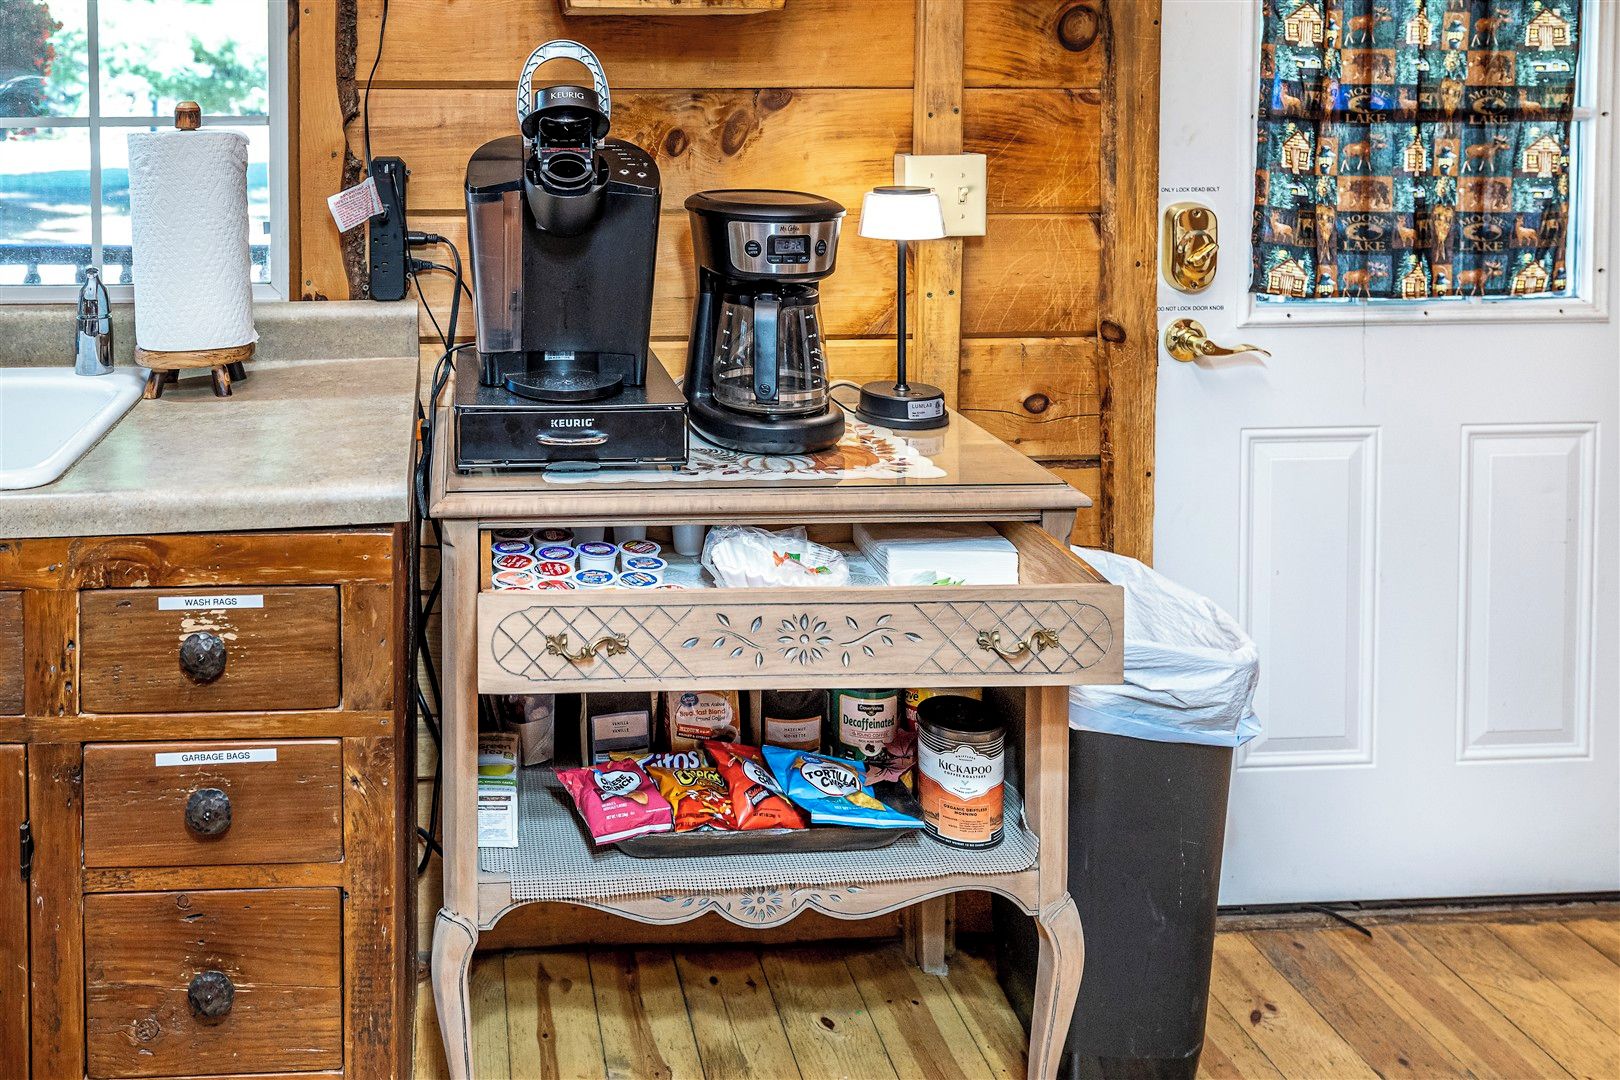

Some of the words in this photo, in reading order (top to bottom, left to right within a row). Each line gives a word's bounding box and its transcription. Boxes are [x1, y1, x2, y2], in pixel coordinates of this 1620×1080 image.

[550, 92, 585, 100] KEURIG
[1344, 87, 1390, 99] MOOSE
[1468, 88, 1512, 101] MOOSE
[1345, 113, 1387, 124] LAKE
[1469, 114, 1509, 125] LAKE
[1341, 213, 1388, 226] MOOSE
[1459, 213, 1507, 226] MOOSE
[1344, 241, 1386, 251] LAKE
[1460, 241, 1503, 251] LAKE
[550, 418, 594, 428] KEURIG
[184, 598, 211, 606] WASH
[212, 597, 238, 606] RAGS
[843, 713, 895, 731] Decaffeinated
[181, 752, 225, 762] GARBAGE
[226, 751, 251, 760] BAGS
[938, 758, 992, 775] KICKAPOO
[804, 769, 858, 789] TORTILLA
[943, 770, 961, 778] COFFEE
[943, 803, 965, 812] ORGANIC
